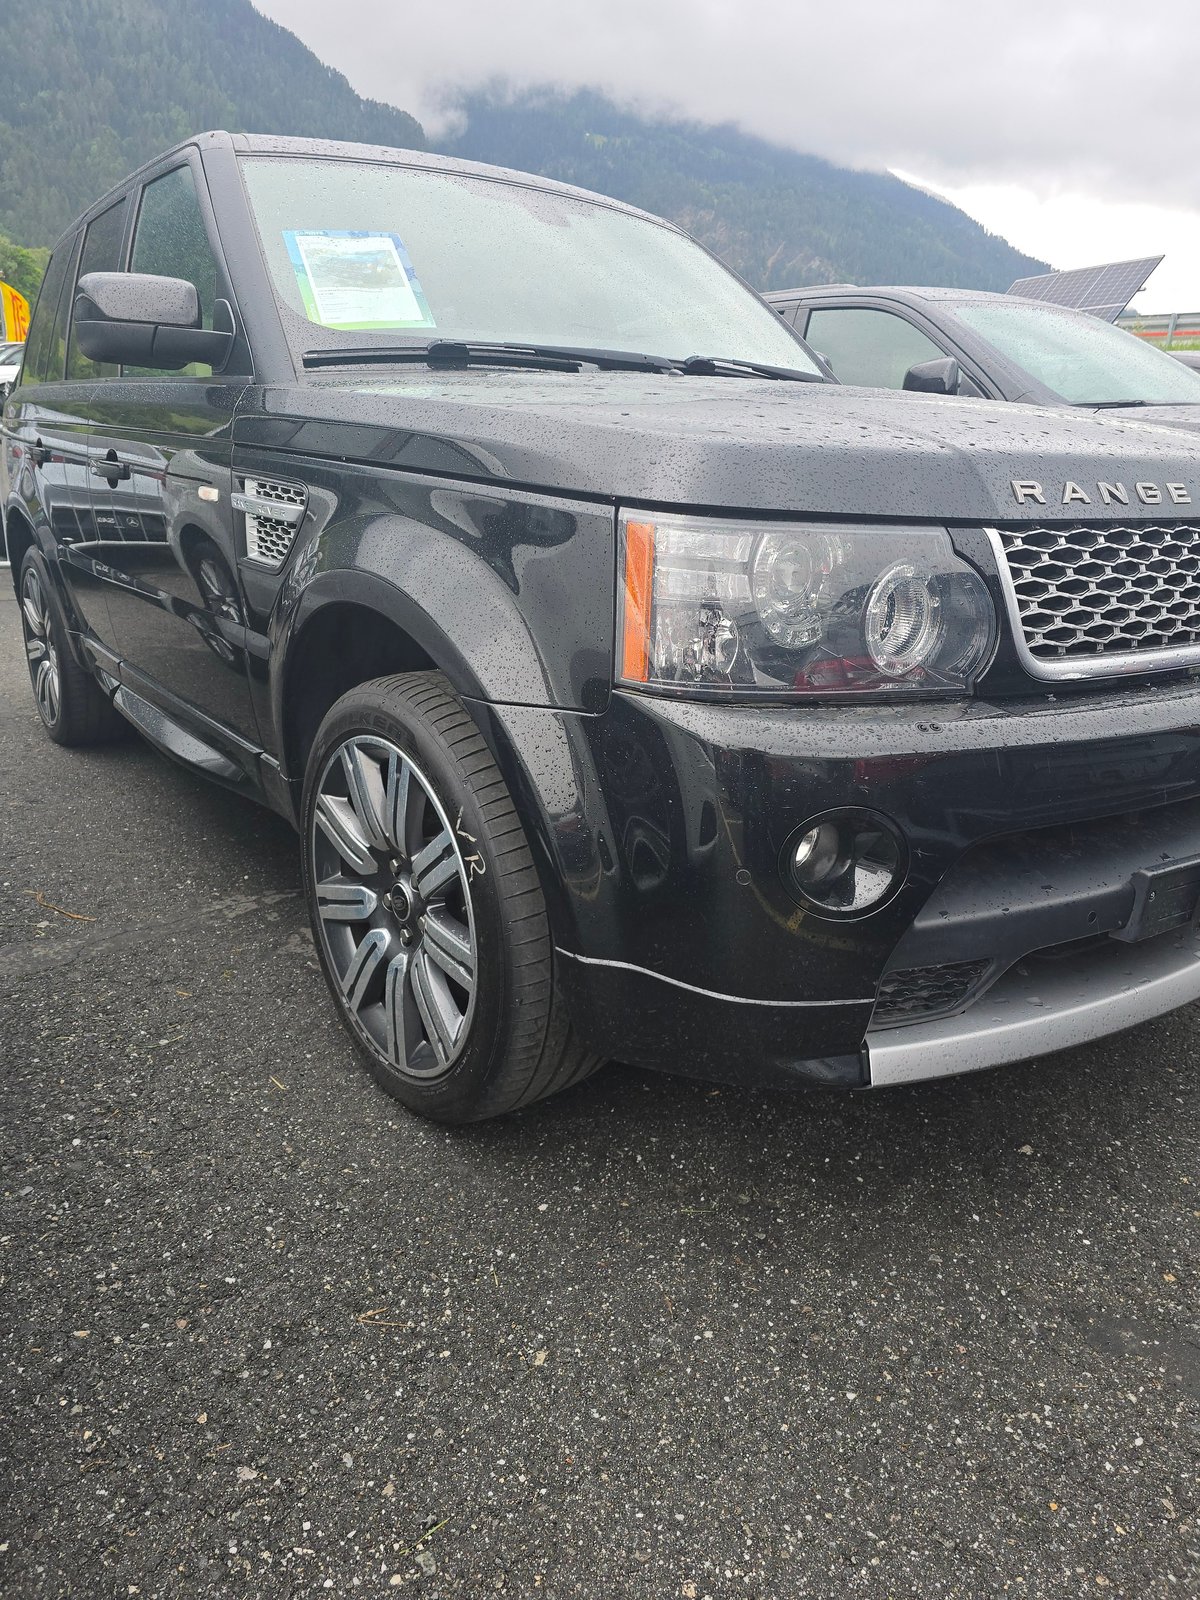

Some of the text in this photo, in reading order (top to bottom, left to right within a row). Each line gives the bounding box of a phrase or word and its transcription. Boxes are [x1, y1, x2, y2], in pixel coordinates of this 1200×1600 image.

[1011, 480, 1192, 505] RANGE
[232, 498, 286, 518] RANGE ROVER
